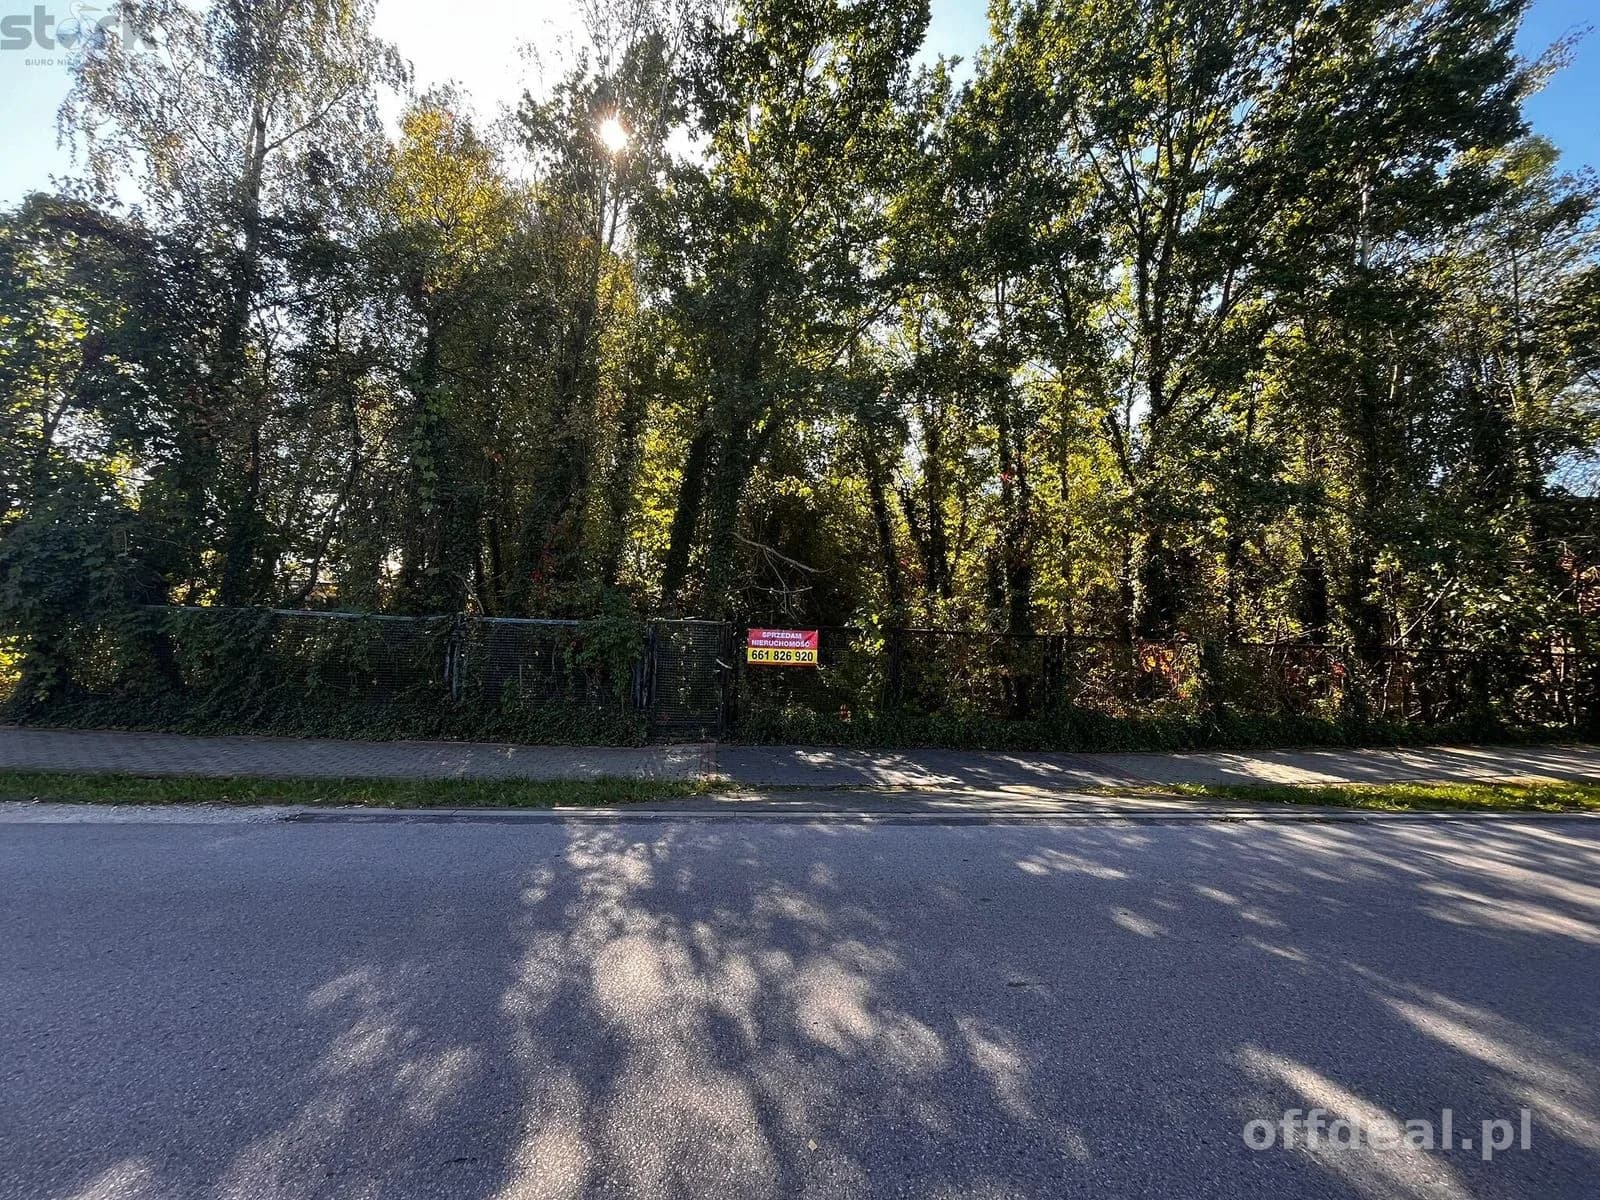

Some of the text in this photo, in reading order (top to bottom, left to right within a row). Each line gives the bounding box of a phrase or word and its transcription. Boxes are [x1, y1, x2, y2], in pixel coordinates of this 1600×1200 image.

[762, 631, 802, 639] SPRZEDAM
[751, 650, 814, 662] 661 826 920
